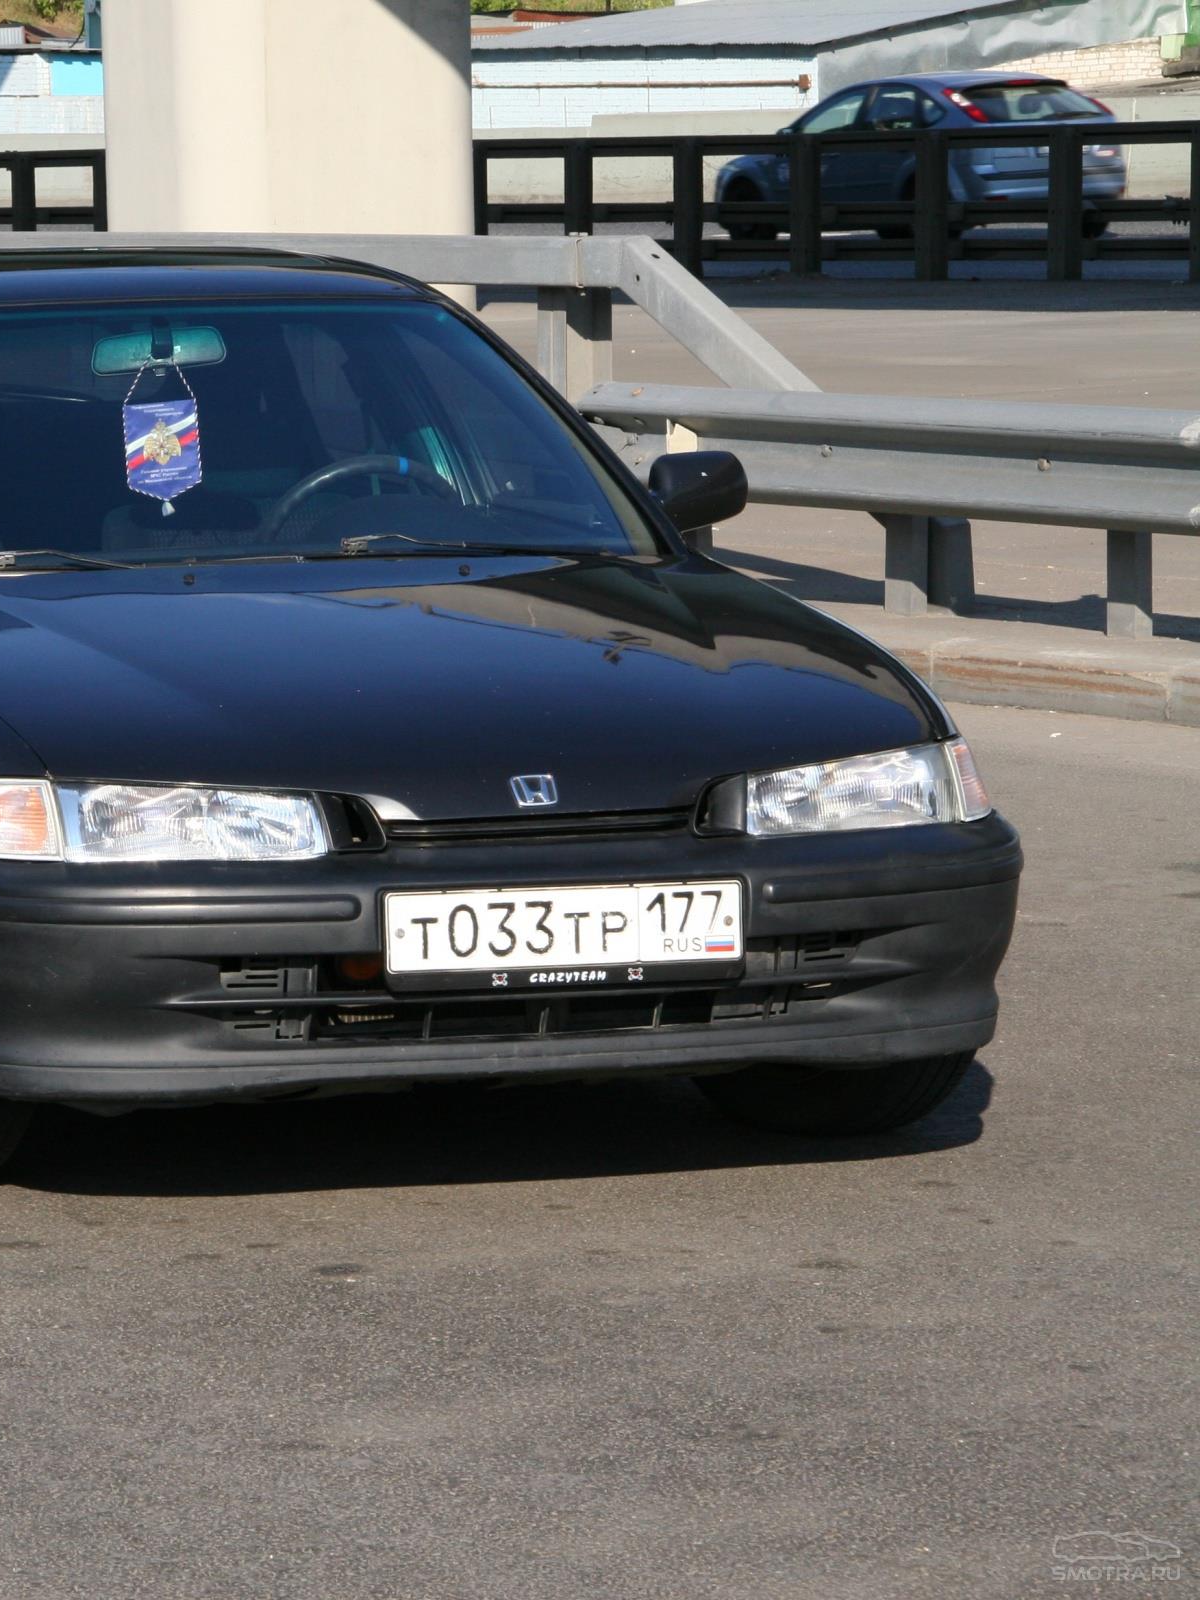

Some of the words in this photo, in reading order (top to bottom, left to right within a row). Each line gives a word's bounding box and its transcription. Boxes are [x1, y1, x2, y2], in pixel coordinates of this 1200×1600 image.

[646, 890, 722, 932] 177
[663, 937, 702, 952] RUS
[529, 970, 607, 983] CRAZYTEAM
